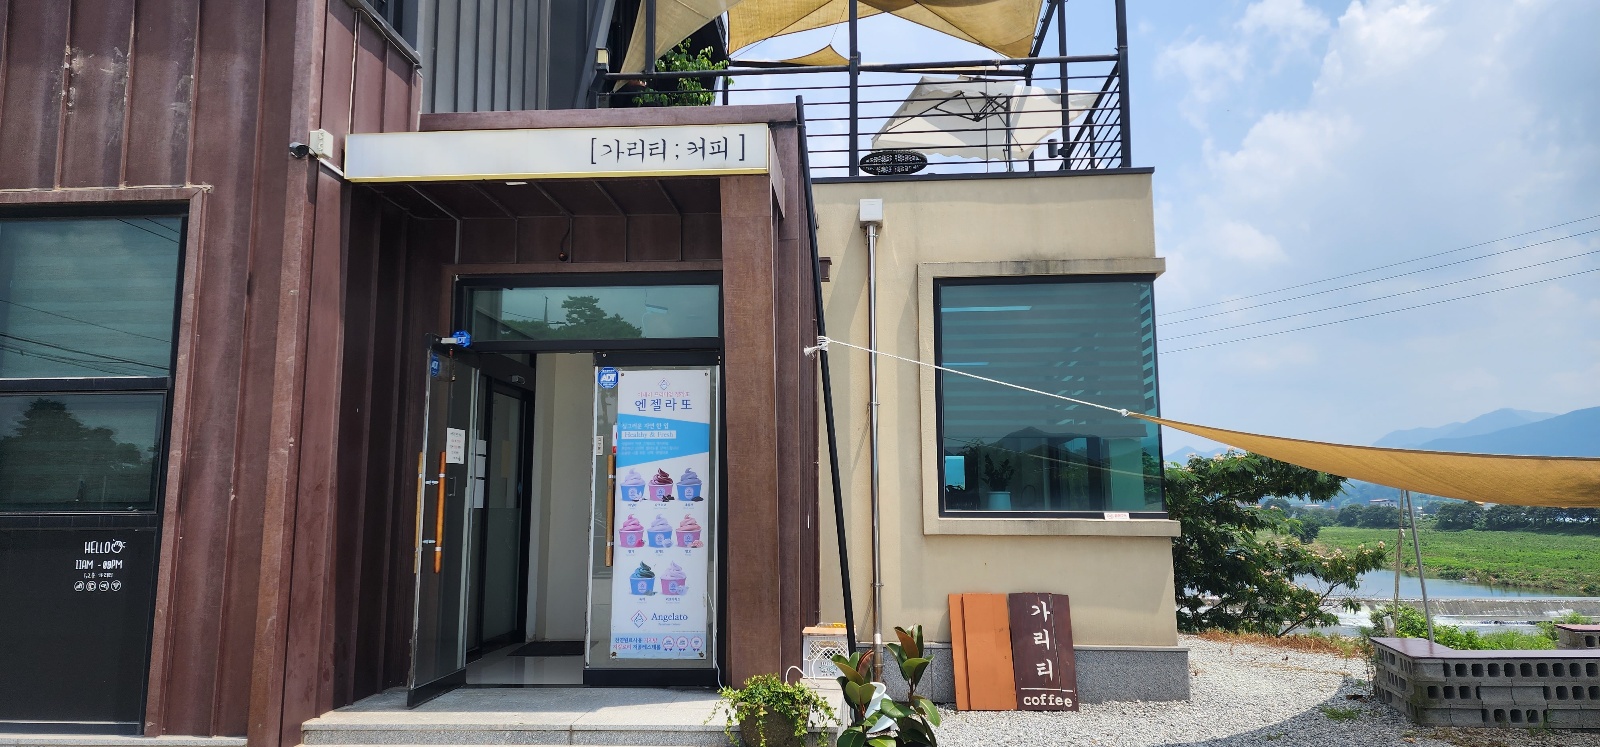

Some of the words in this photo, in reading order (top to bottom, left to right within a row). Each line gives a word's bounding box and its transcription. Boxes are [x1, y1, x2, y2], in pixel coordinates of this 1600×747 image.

[601, 373, 617, 382] ADT
[635, 398, 692, 411] 엔젤라또
[85, 541, 110, 554] HELLO
[75, 560, 93, 569] 11AM
[651, 612, 688, 622] Angelato
[1023, 693, 1073, 708] coffee
